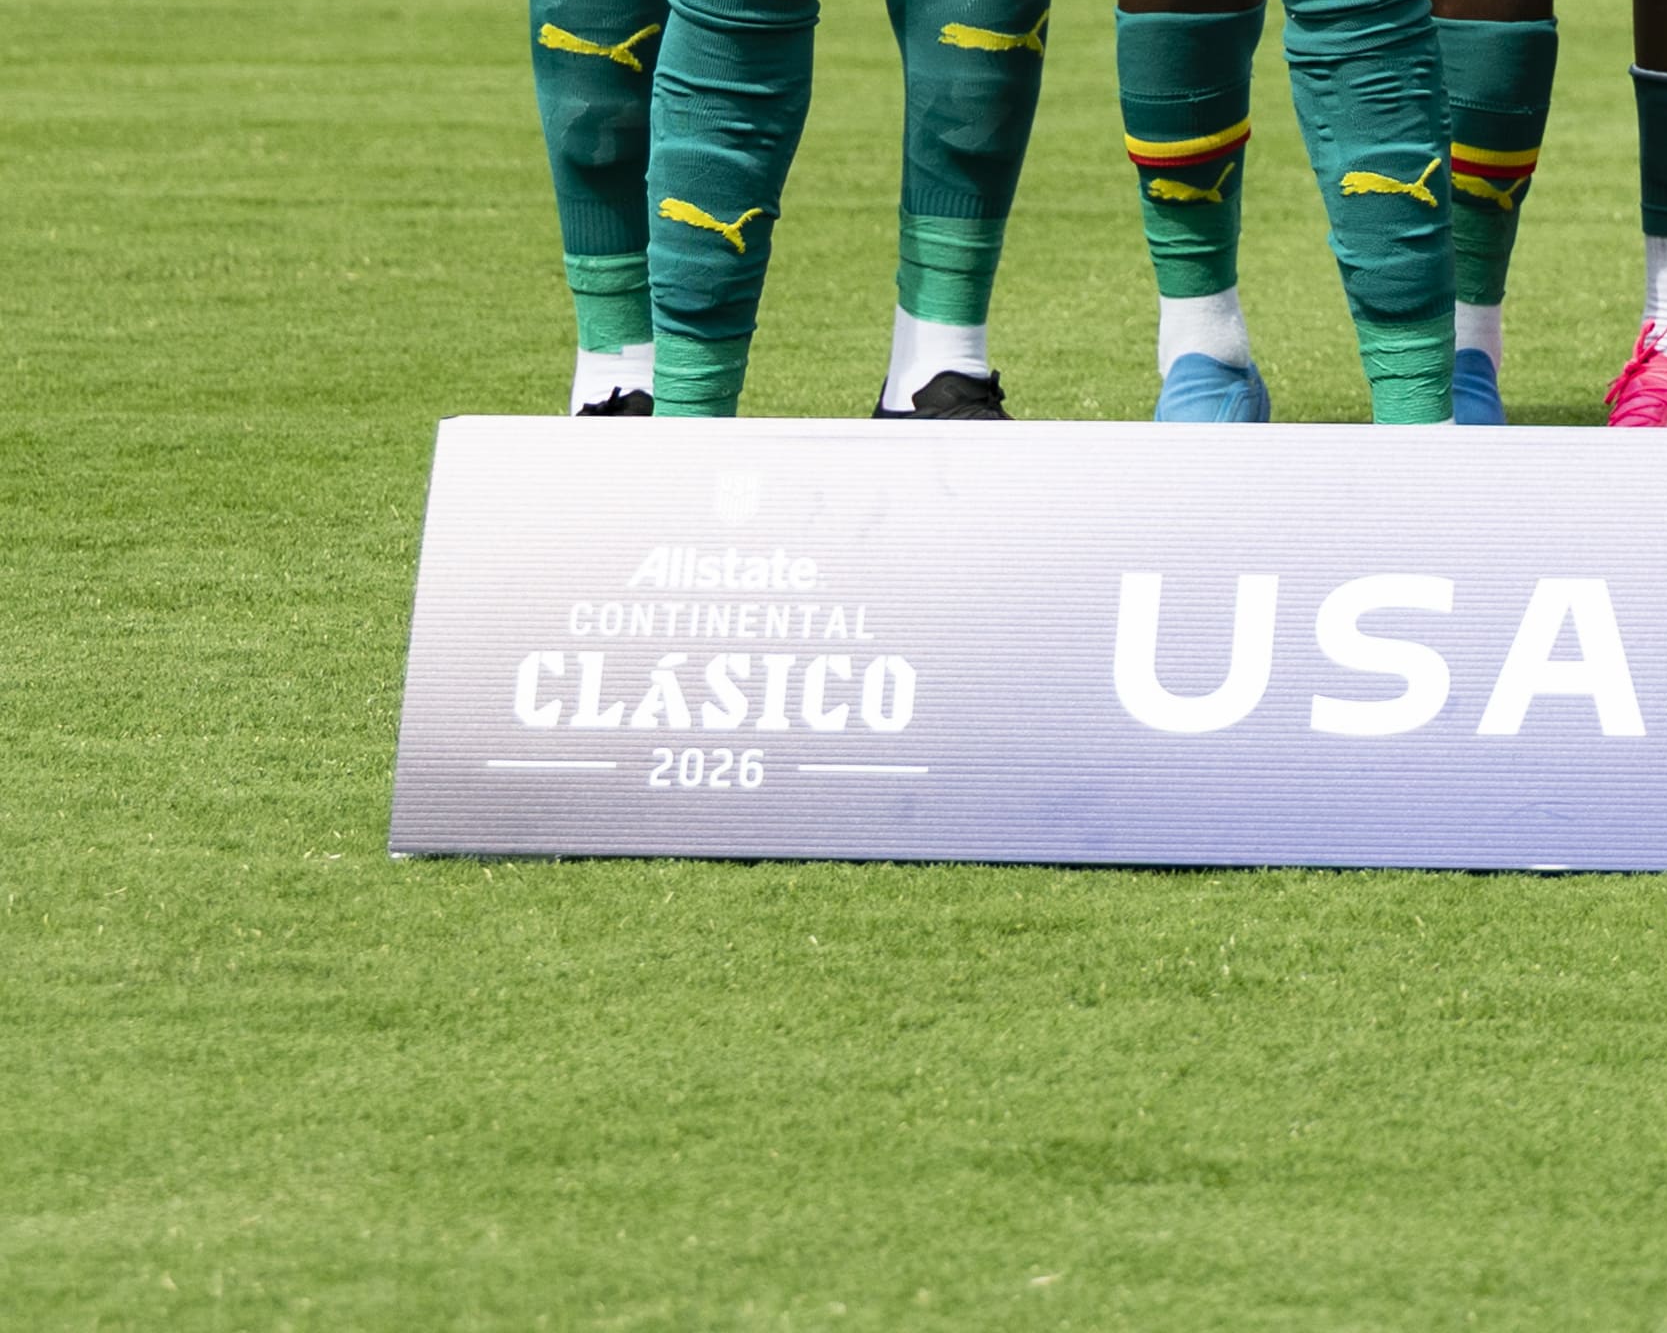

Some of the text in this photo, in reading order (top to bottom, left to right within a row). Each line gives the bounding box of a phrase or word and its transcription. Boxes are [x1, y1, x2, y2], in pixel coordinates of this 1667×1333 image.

[626, 547, 820, 591] Allstate
[567, 602, 876, 640] CONTINENTAL
[1112, 571, 1648, 737] USA
[513, 650, 917, 732] CLÁSICO
[648, 747, 765, 788] 2026
